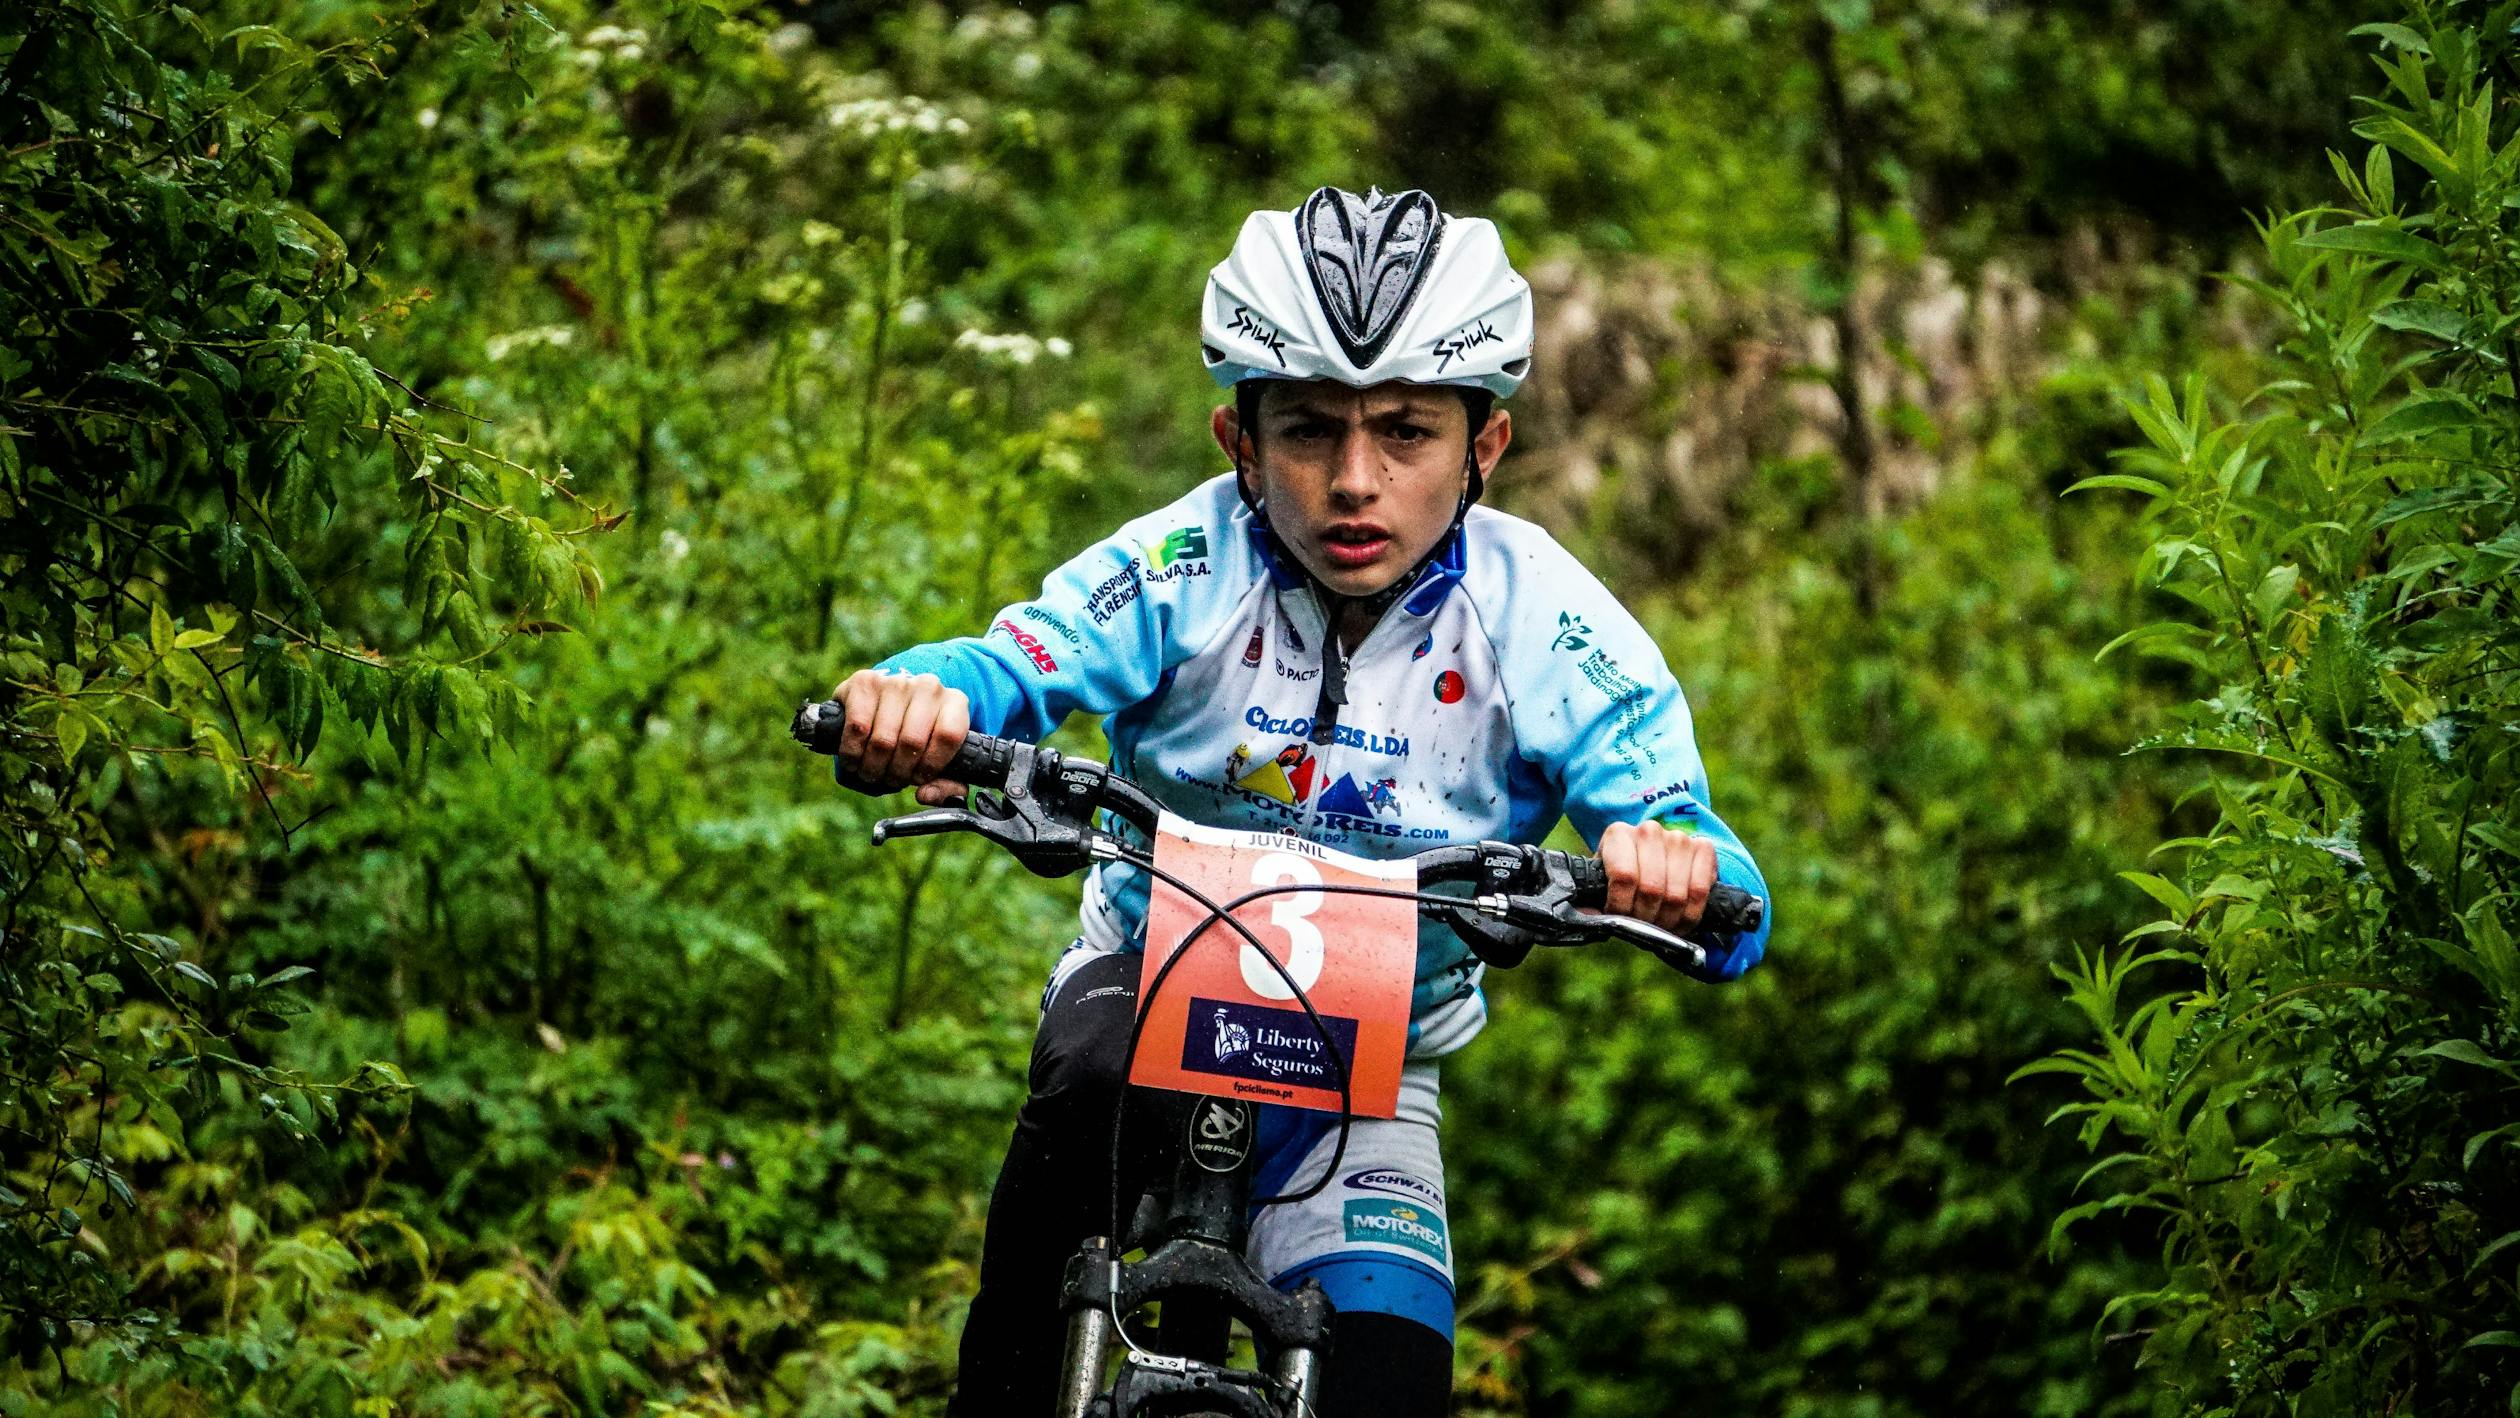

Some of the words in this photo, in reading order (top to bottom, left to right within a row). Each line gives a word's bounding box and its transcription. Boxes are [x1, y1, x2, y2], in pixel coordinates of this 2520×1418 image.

[1060, 771, 1100, 787] Deore
[1249, 833, 1328, 860] JUVENIL
[1484, 857, 1521, 869] Deore
[1239, 852, 1325, 1001] 3
[1256, 1027, 1324, 1059] Liberty
[1251, 1051, 1324, 1077] Seguros
[1352, 1214, 1444, 1250] MOTOREX
